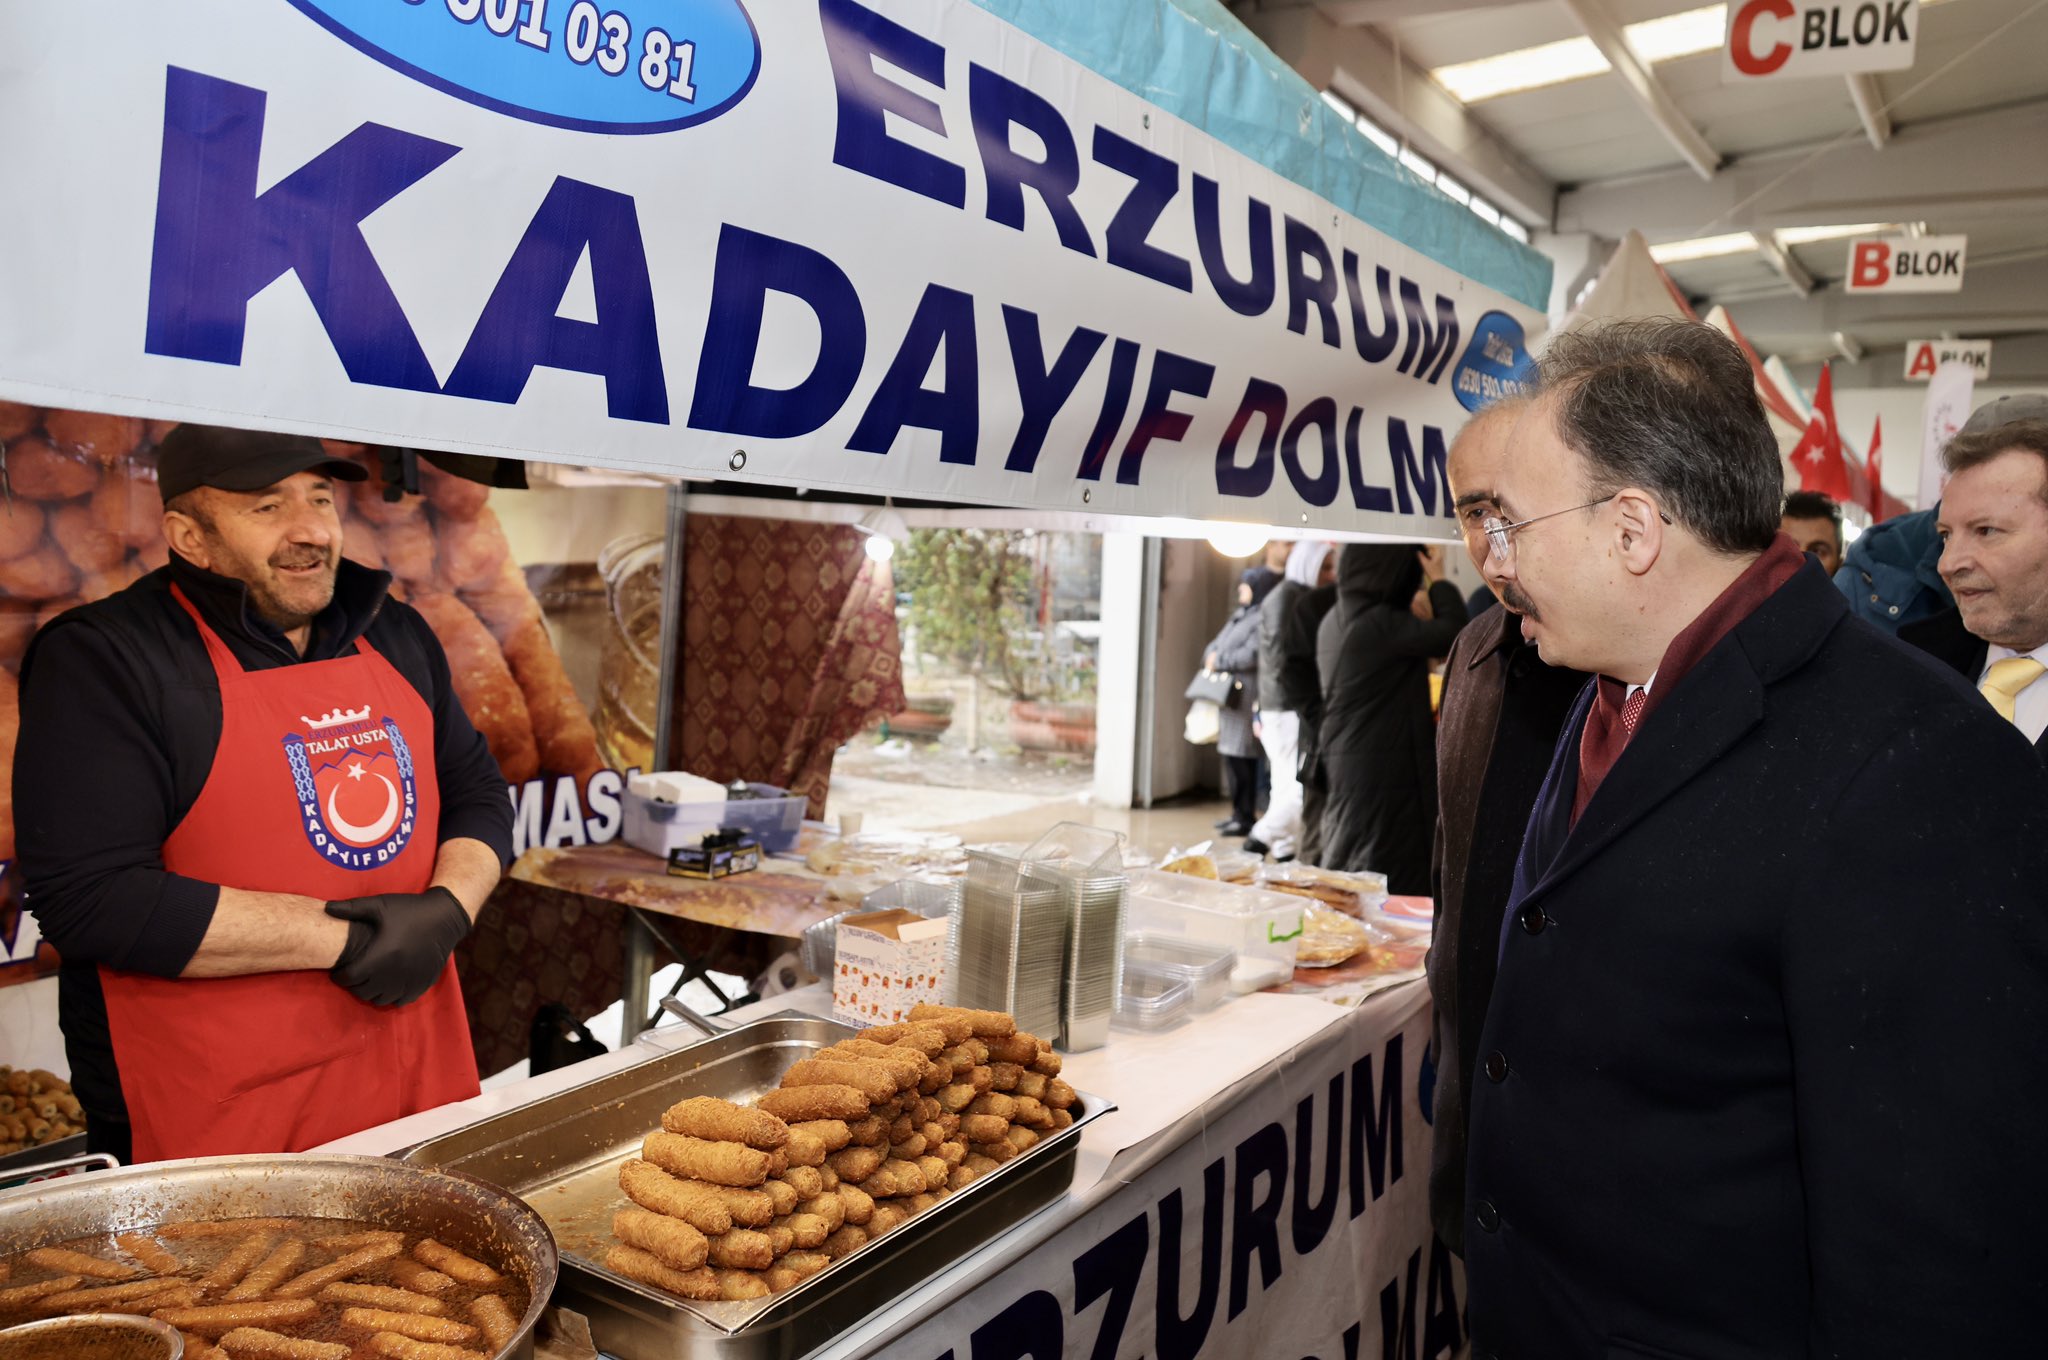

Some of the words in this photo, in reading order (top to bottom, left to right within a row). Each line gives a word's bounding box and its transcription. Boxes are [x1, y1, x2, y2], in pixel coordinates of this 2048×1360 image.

[564, 0, 632, 75] 03
[639, 28, 696, 103] 81
[1730, 0, 1795, 76] C
[1802, 1, 1909, 50] BLOK
[818, 0, 1459, 384] ERZURUM
[145, 64, 1216, 485] KADAYIF
[1852, 242, 1890, 288] B
[1896, 250, 1959, 276] BLOK
[1909, 342, 1937, 376] A
[306, 736, 350, 754] TALAT
[352, 729, 389, 746] USTA
[308, 720, 377, 740] ERZURUM'LU
[305, 803, 372, 866] KADAYIF
[377, 781, 414, 861] DOLMASI
[935, 1033, 1404, 1360] ZURUM
